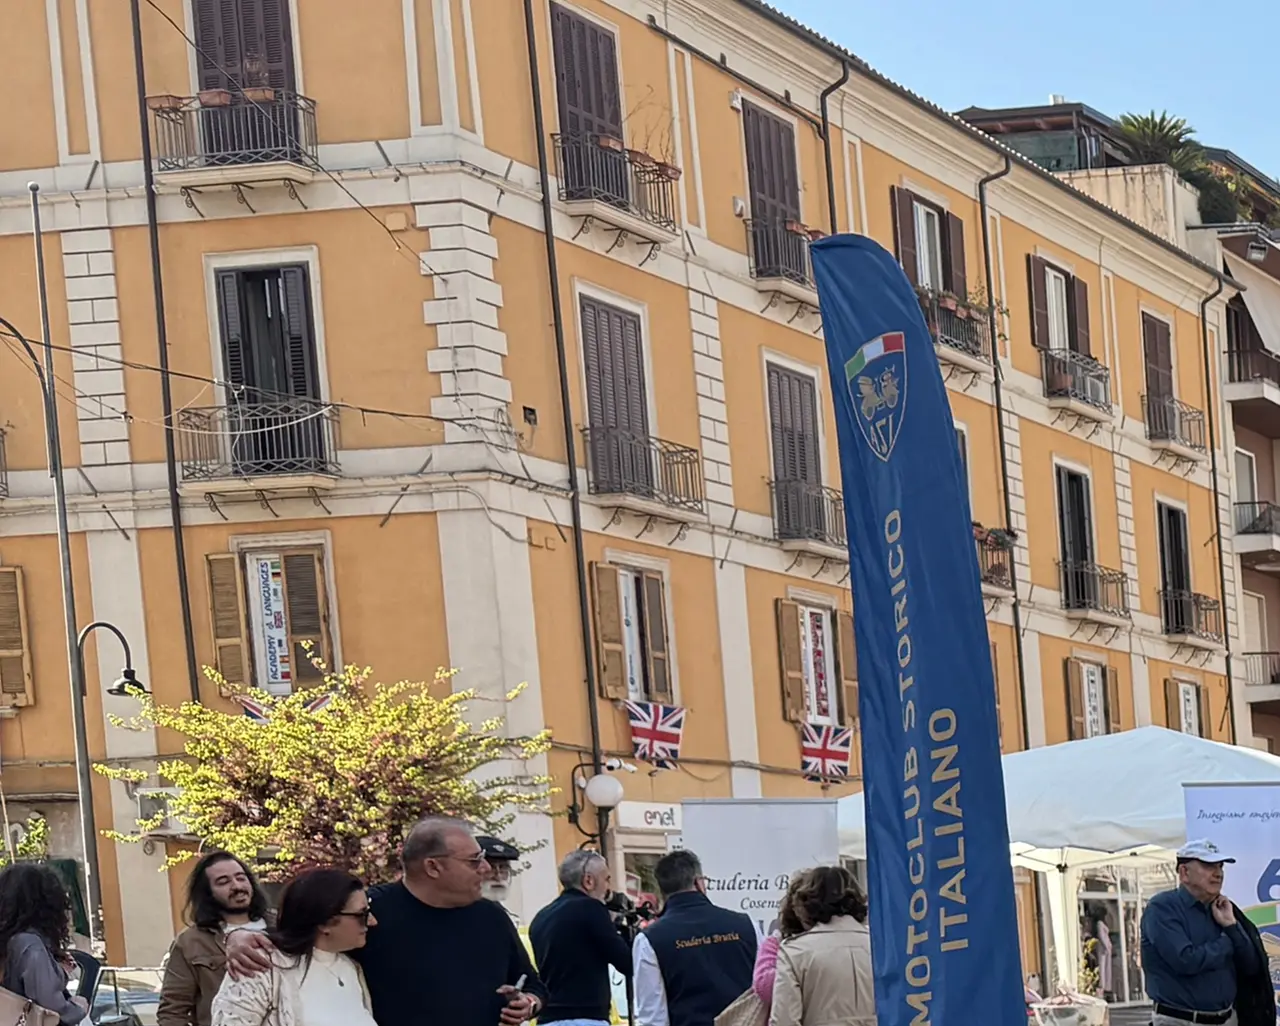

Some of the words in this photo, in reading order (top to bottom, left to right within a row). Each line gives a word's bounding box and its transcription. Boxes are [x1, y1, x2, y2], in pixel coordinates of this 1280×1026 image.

[259, 561, 273, 617] LANGUAGES
[884, 509, 915, 733] STORICO
[267, 635, 279, 680] ACADEMY
[644, 807, 675, 826] enel
[928, 707, 969, 952] ITALIANO
[705, 871, 769, 891] cuderia
[740, 897, 780, 910] Cosenz
